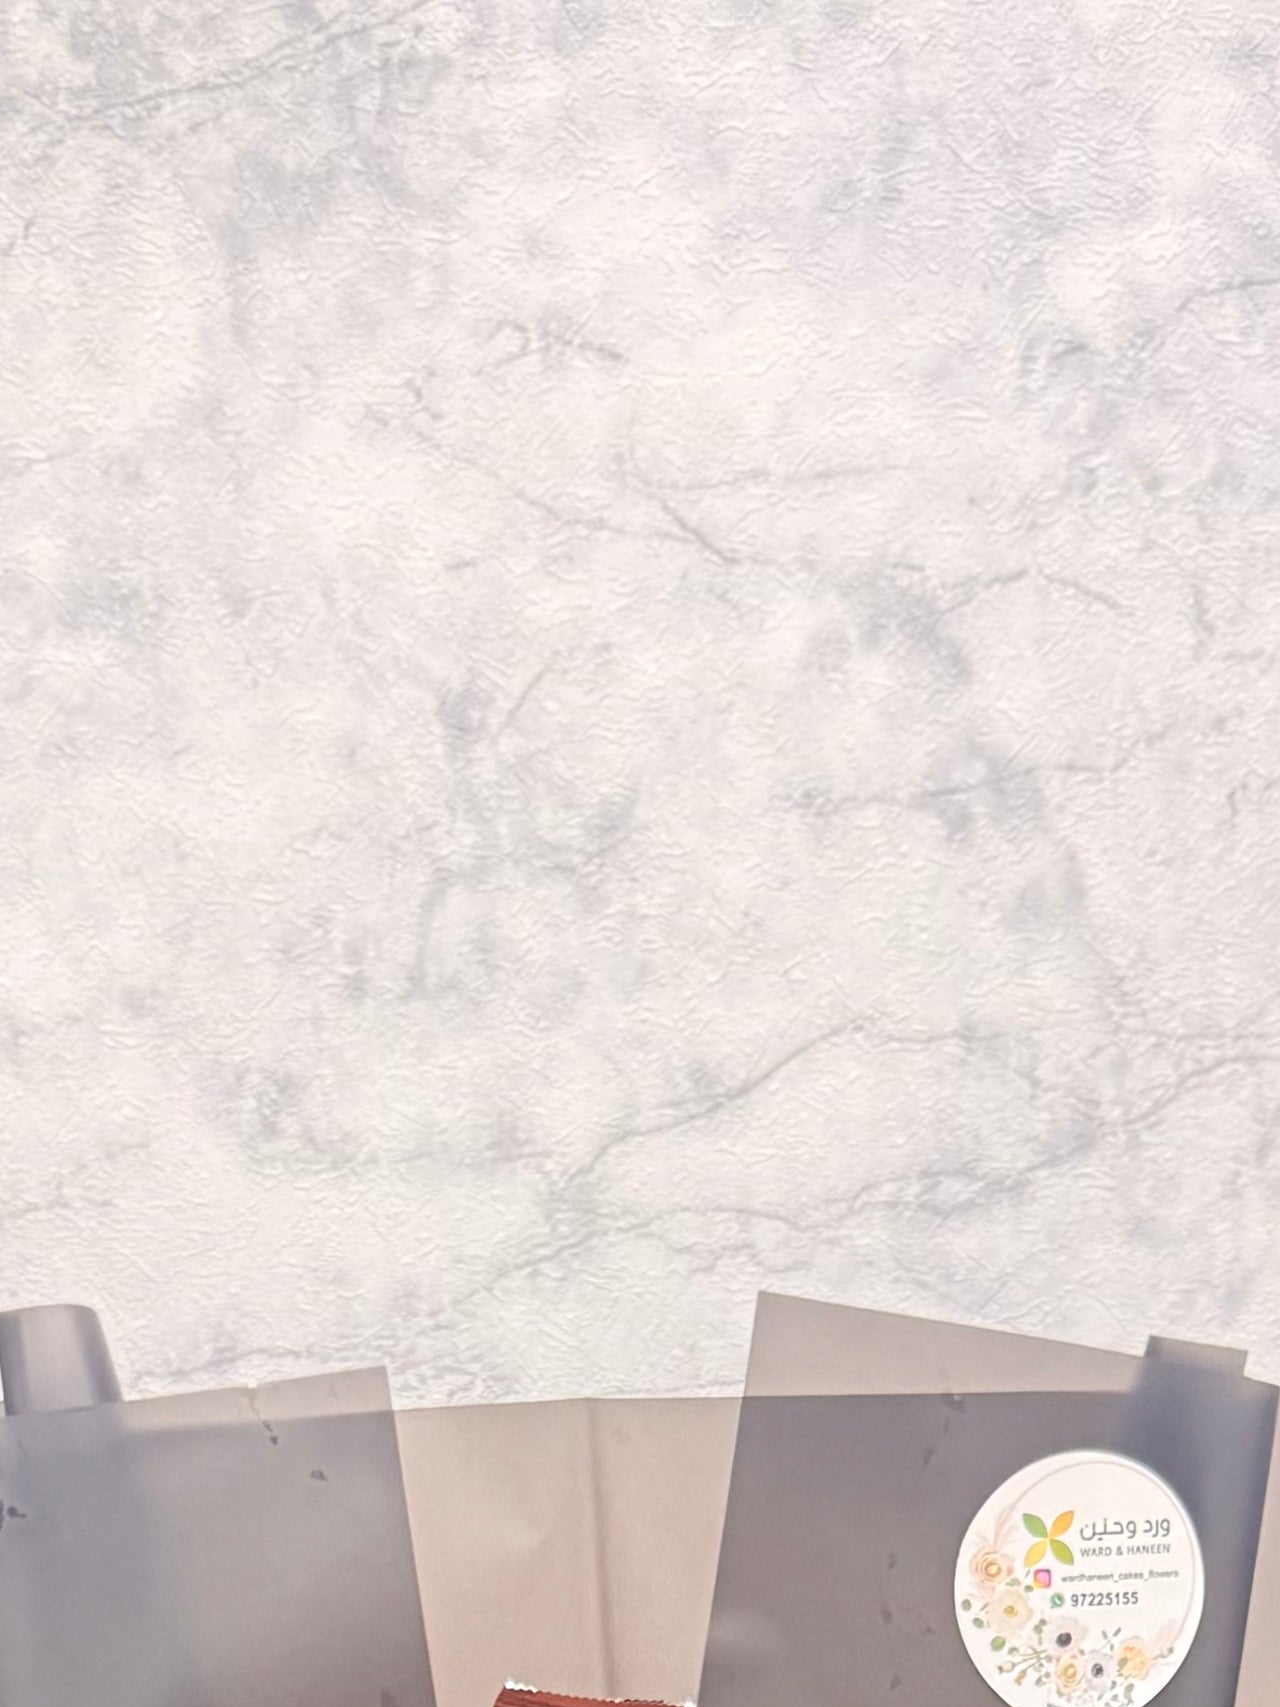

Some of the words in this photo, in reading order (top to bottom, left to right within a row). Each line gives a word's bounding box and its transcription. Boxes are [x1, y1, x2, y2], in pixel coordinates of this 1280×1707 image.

[1080, 1518, 1137, 1541] وحنين
[1143, 1518, 1170, 1538] ورد
[1080, 1546, 1112, 1557] WARD
[1116, 1546, 1123, 1556] &
[1127, 1544, 1171, 1555] HANEEN
[1071, 1592, 1139, 1607] 97225155
